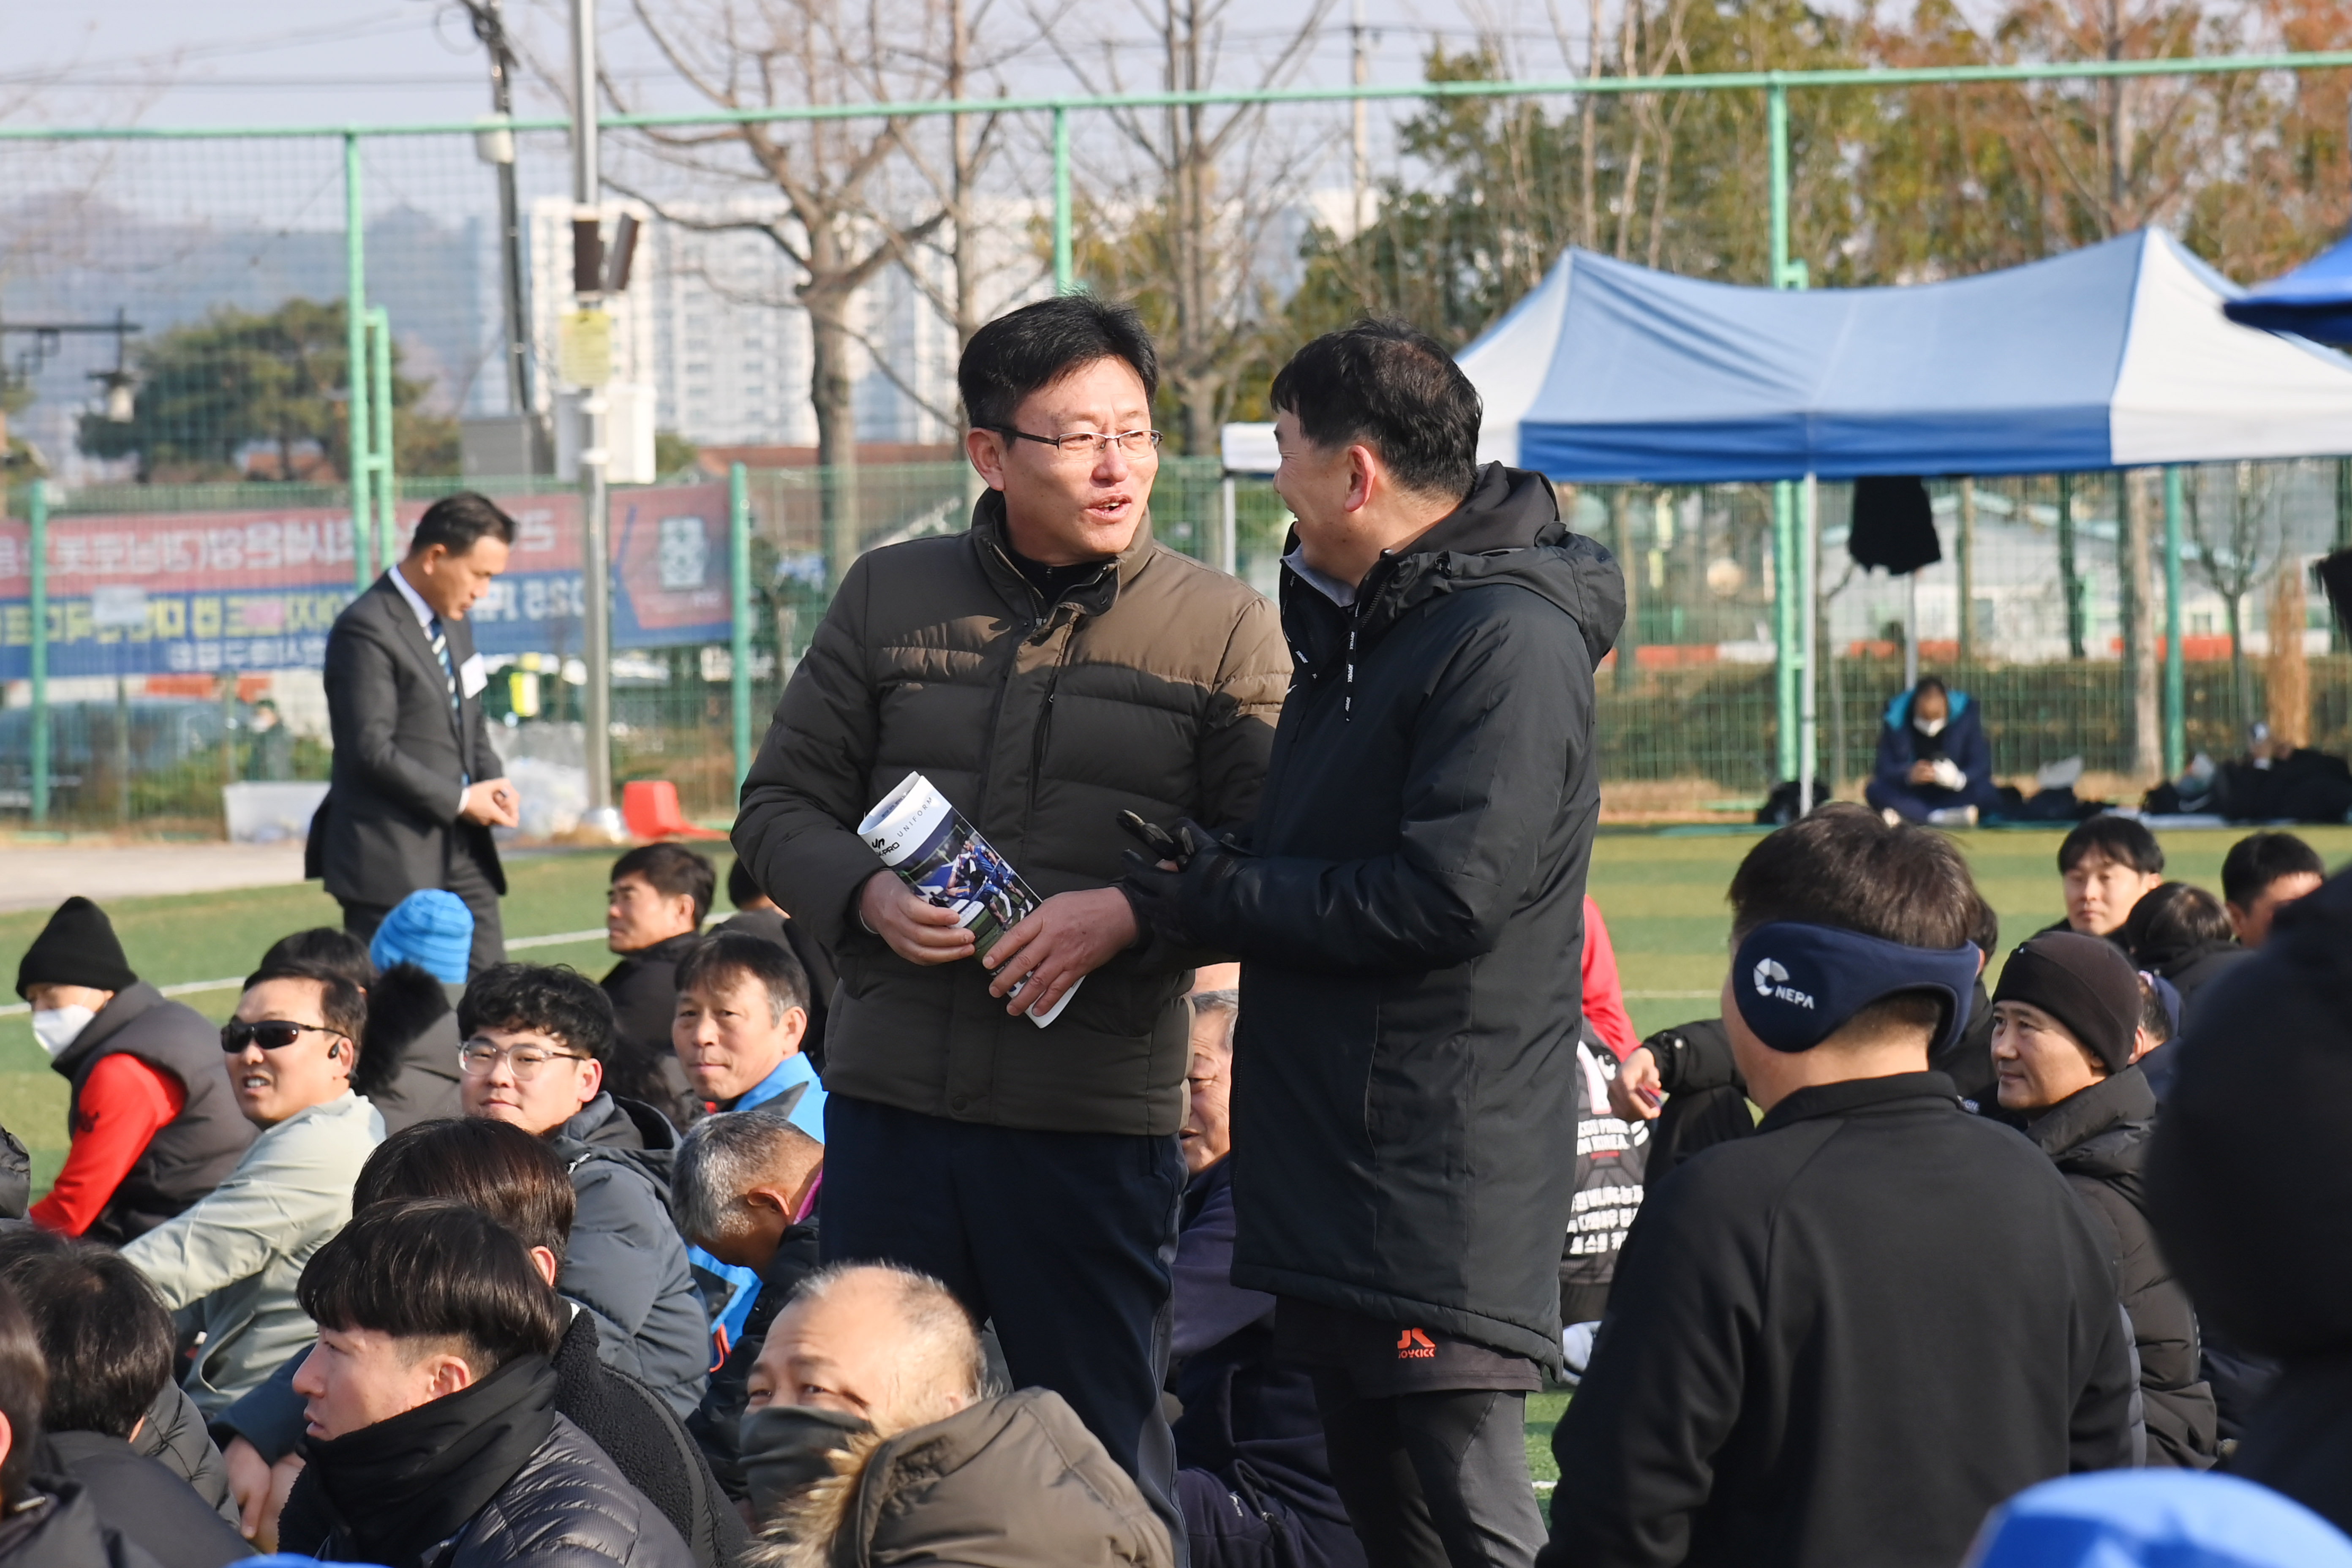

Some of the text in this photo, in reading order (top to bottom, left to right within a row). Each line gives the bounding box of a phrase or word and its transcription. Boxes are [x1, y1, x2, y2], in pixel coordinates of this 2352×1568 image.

[897, 796, 932, 837] UNIFORM
[1774, 985, 1815, 1010] NEPA
[1398, 1348, 1435, 1358] JOYKICK
